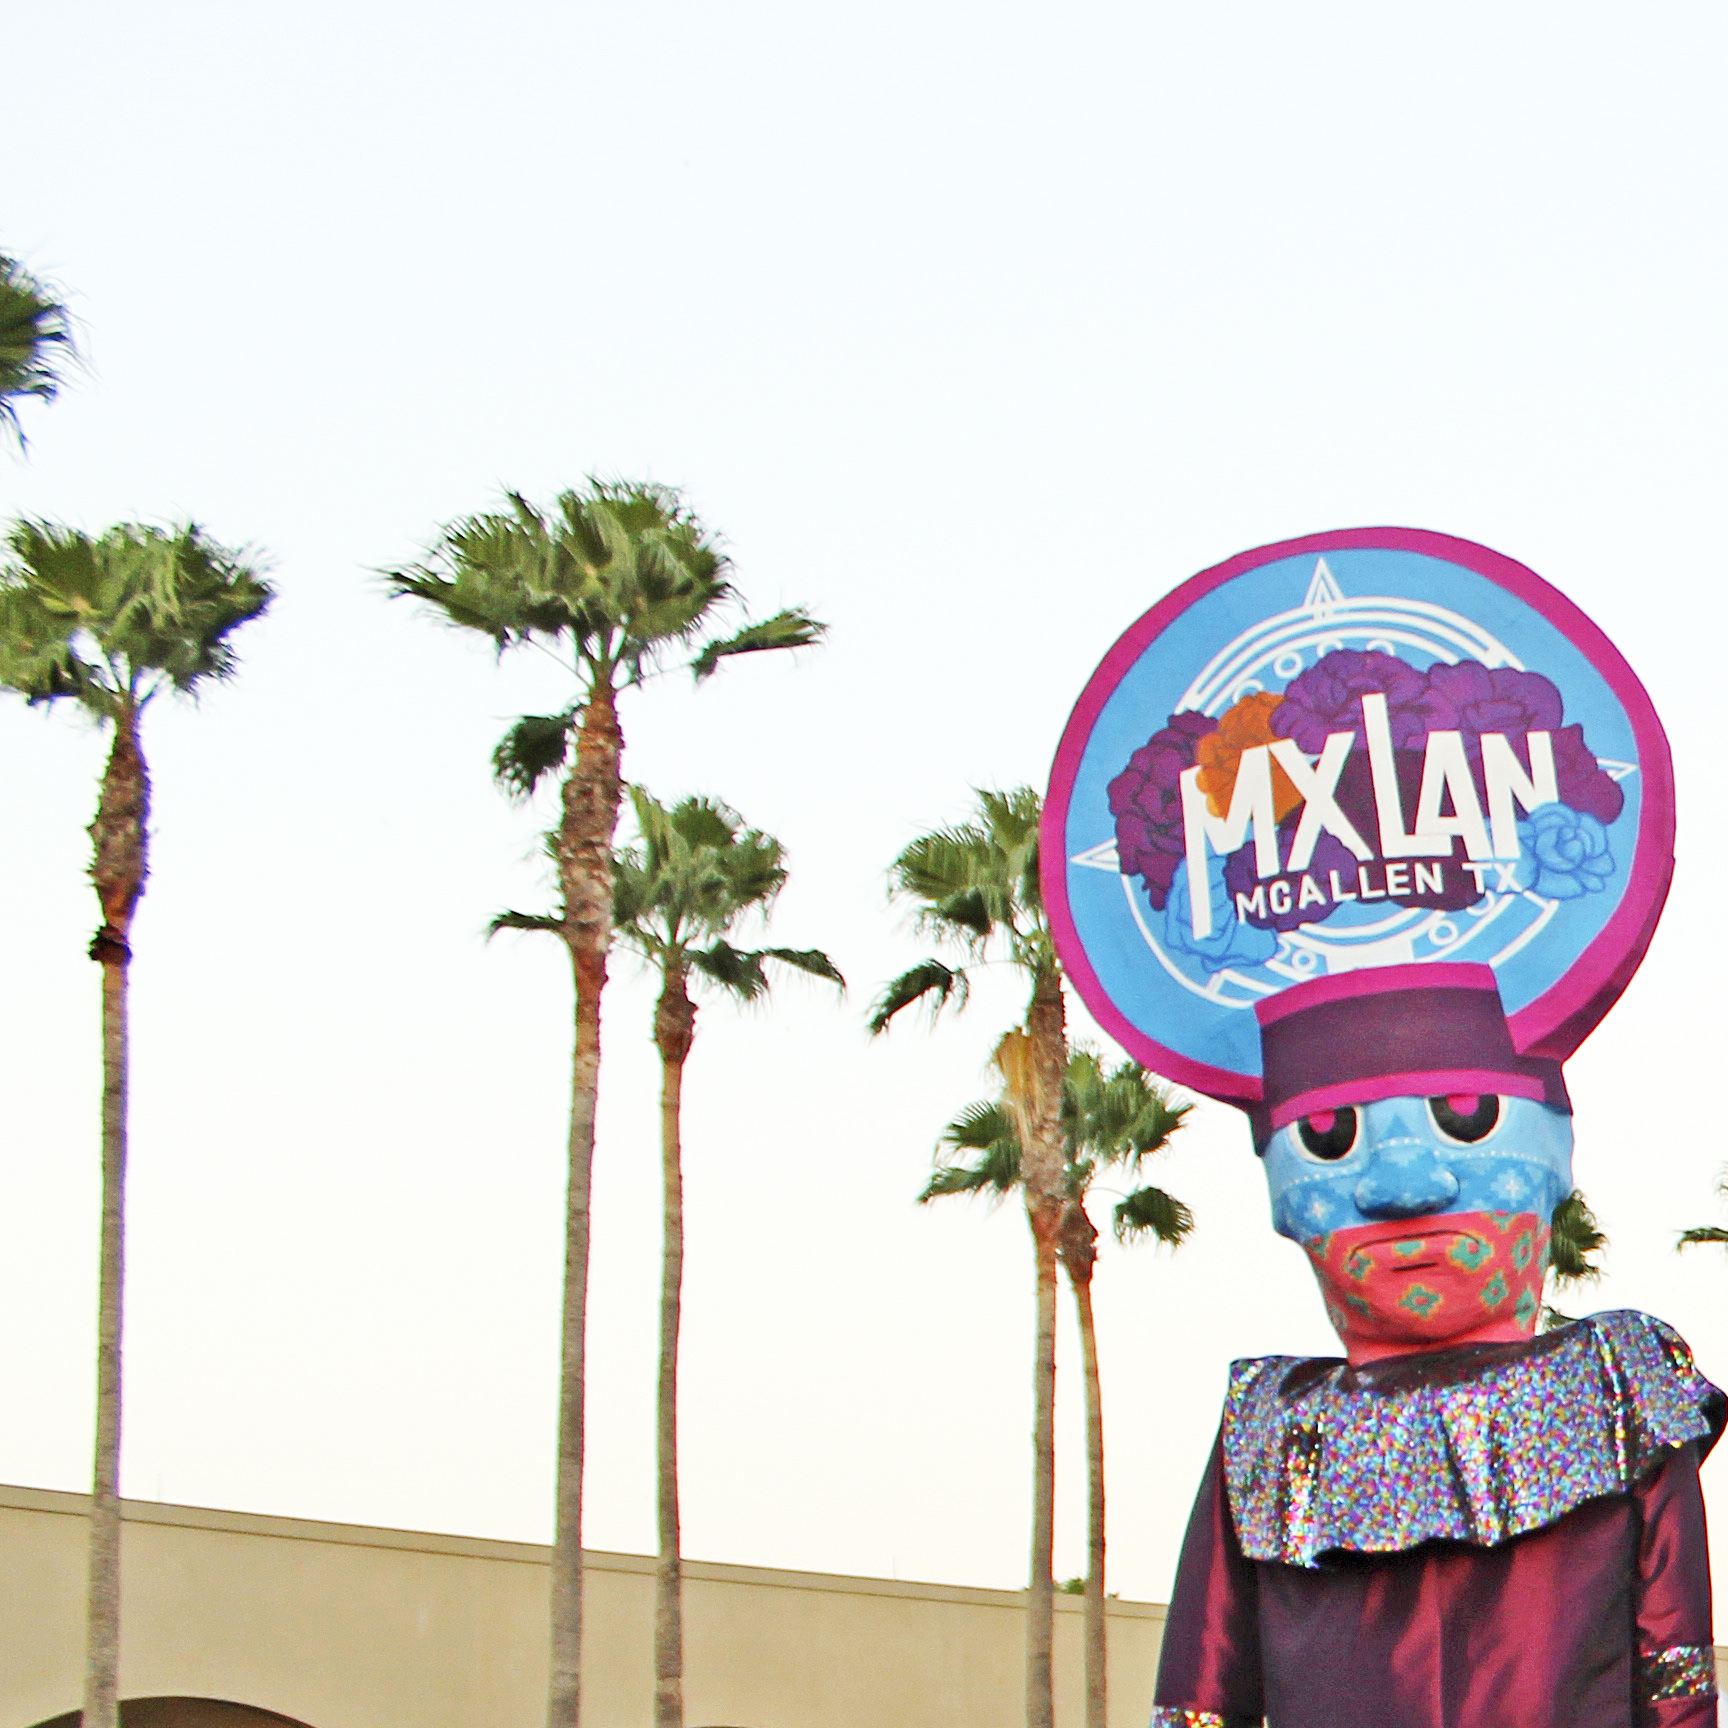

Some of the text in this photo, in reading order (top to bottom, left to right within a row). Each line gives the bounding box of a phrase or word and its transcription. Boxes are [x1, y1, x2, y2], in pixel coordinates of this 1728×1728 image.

[1179, 692, 1559, 941] MXLAN
[1235, 861, 1525, 924] MCALLEN TX
